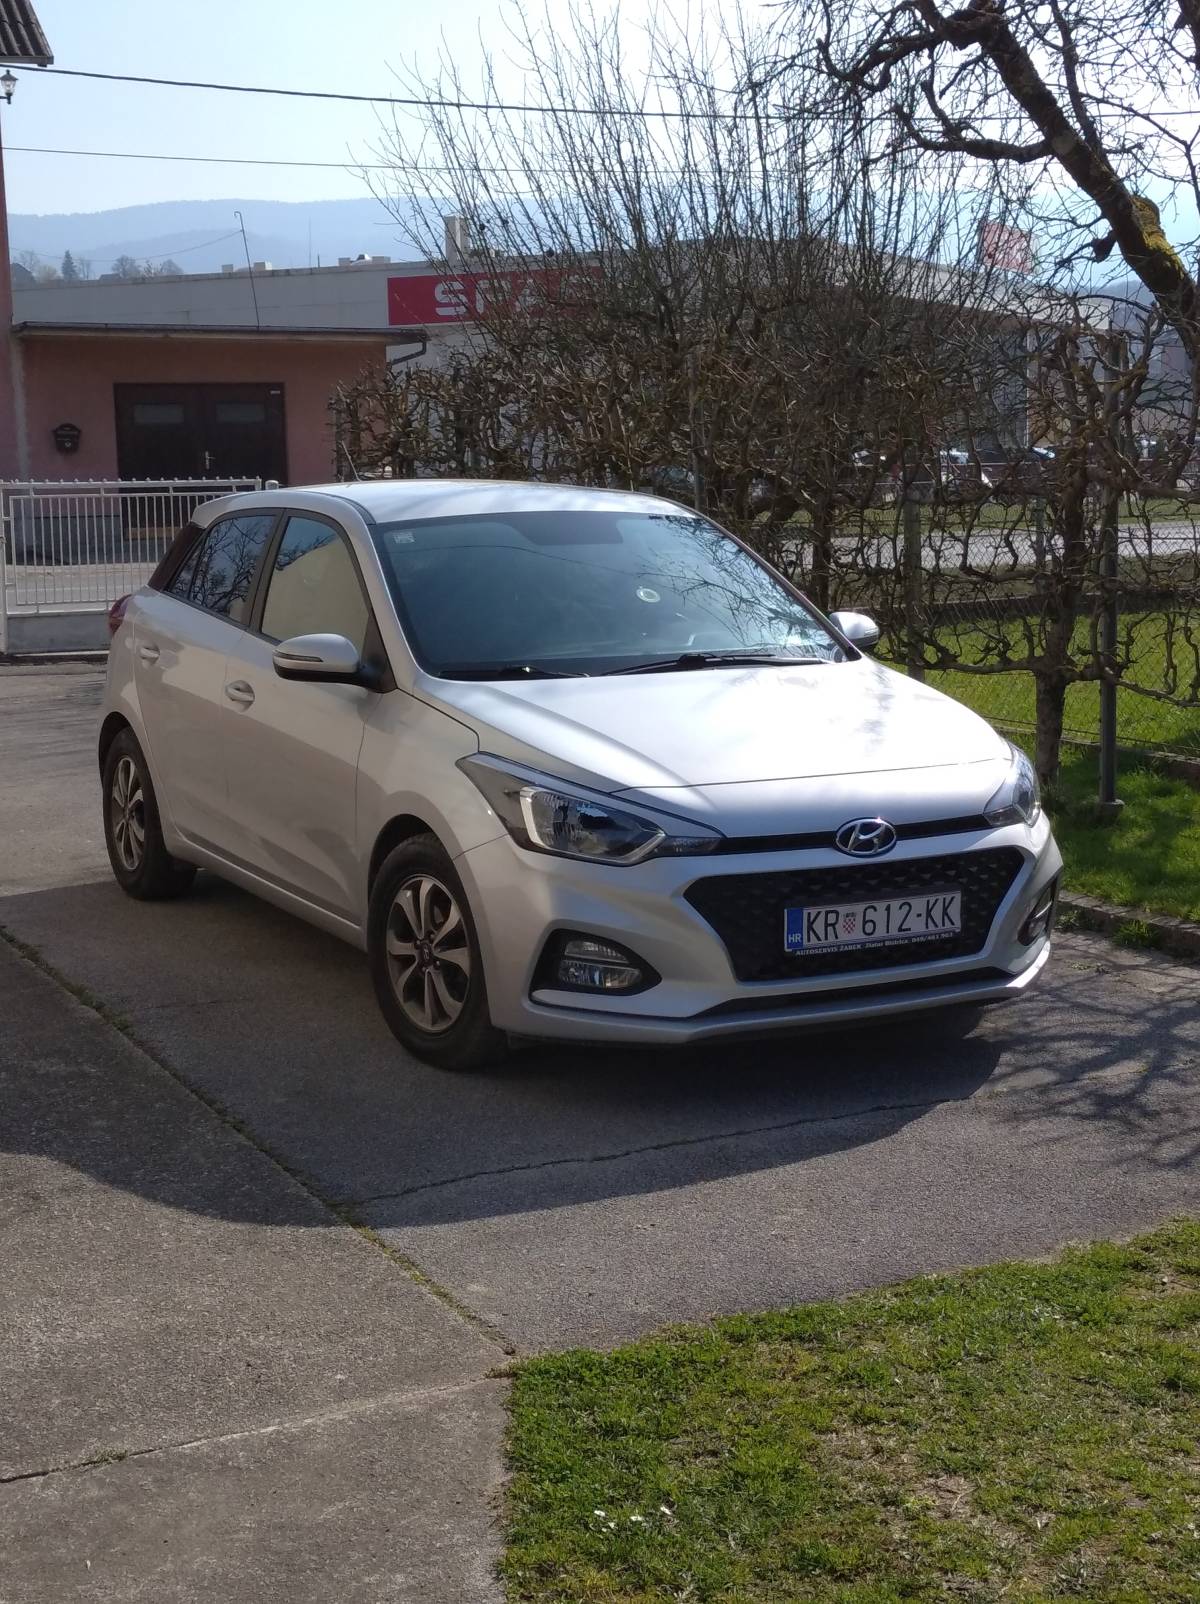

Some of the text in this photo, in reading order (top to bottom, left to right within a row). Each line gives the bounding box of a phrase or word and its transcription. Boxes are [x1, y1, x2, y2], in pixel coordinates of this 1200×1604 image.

[806, 896, 956, 943] KR 612-KK
[788, 934, 802, 943] HR
